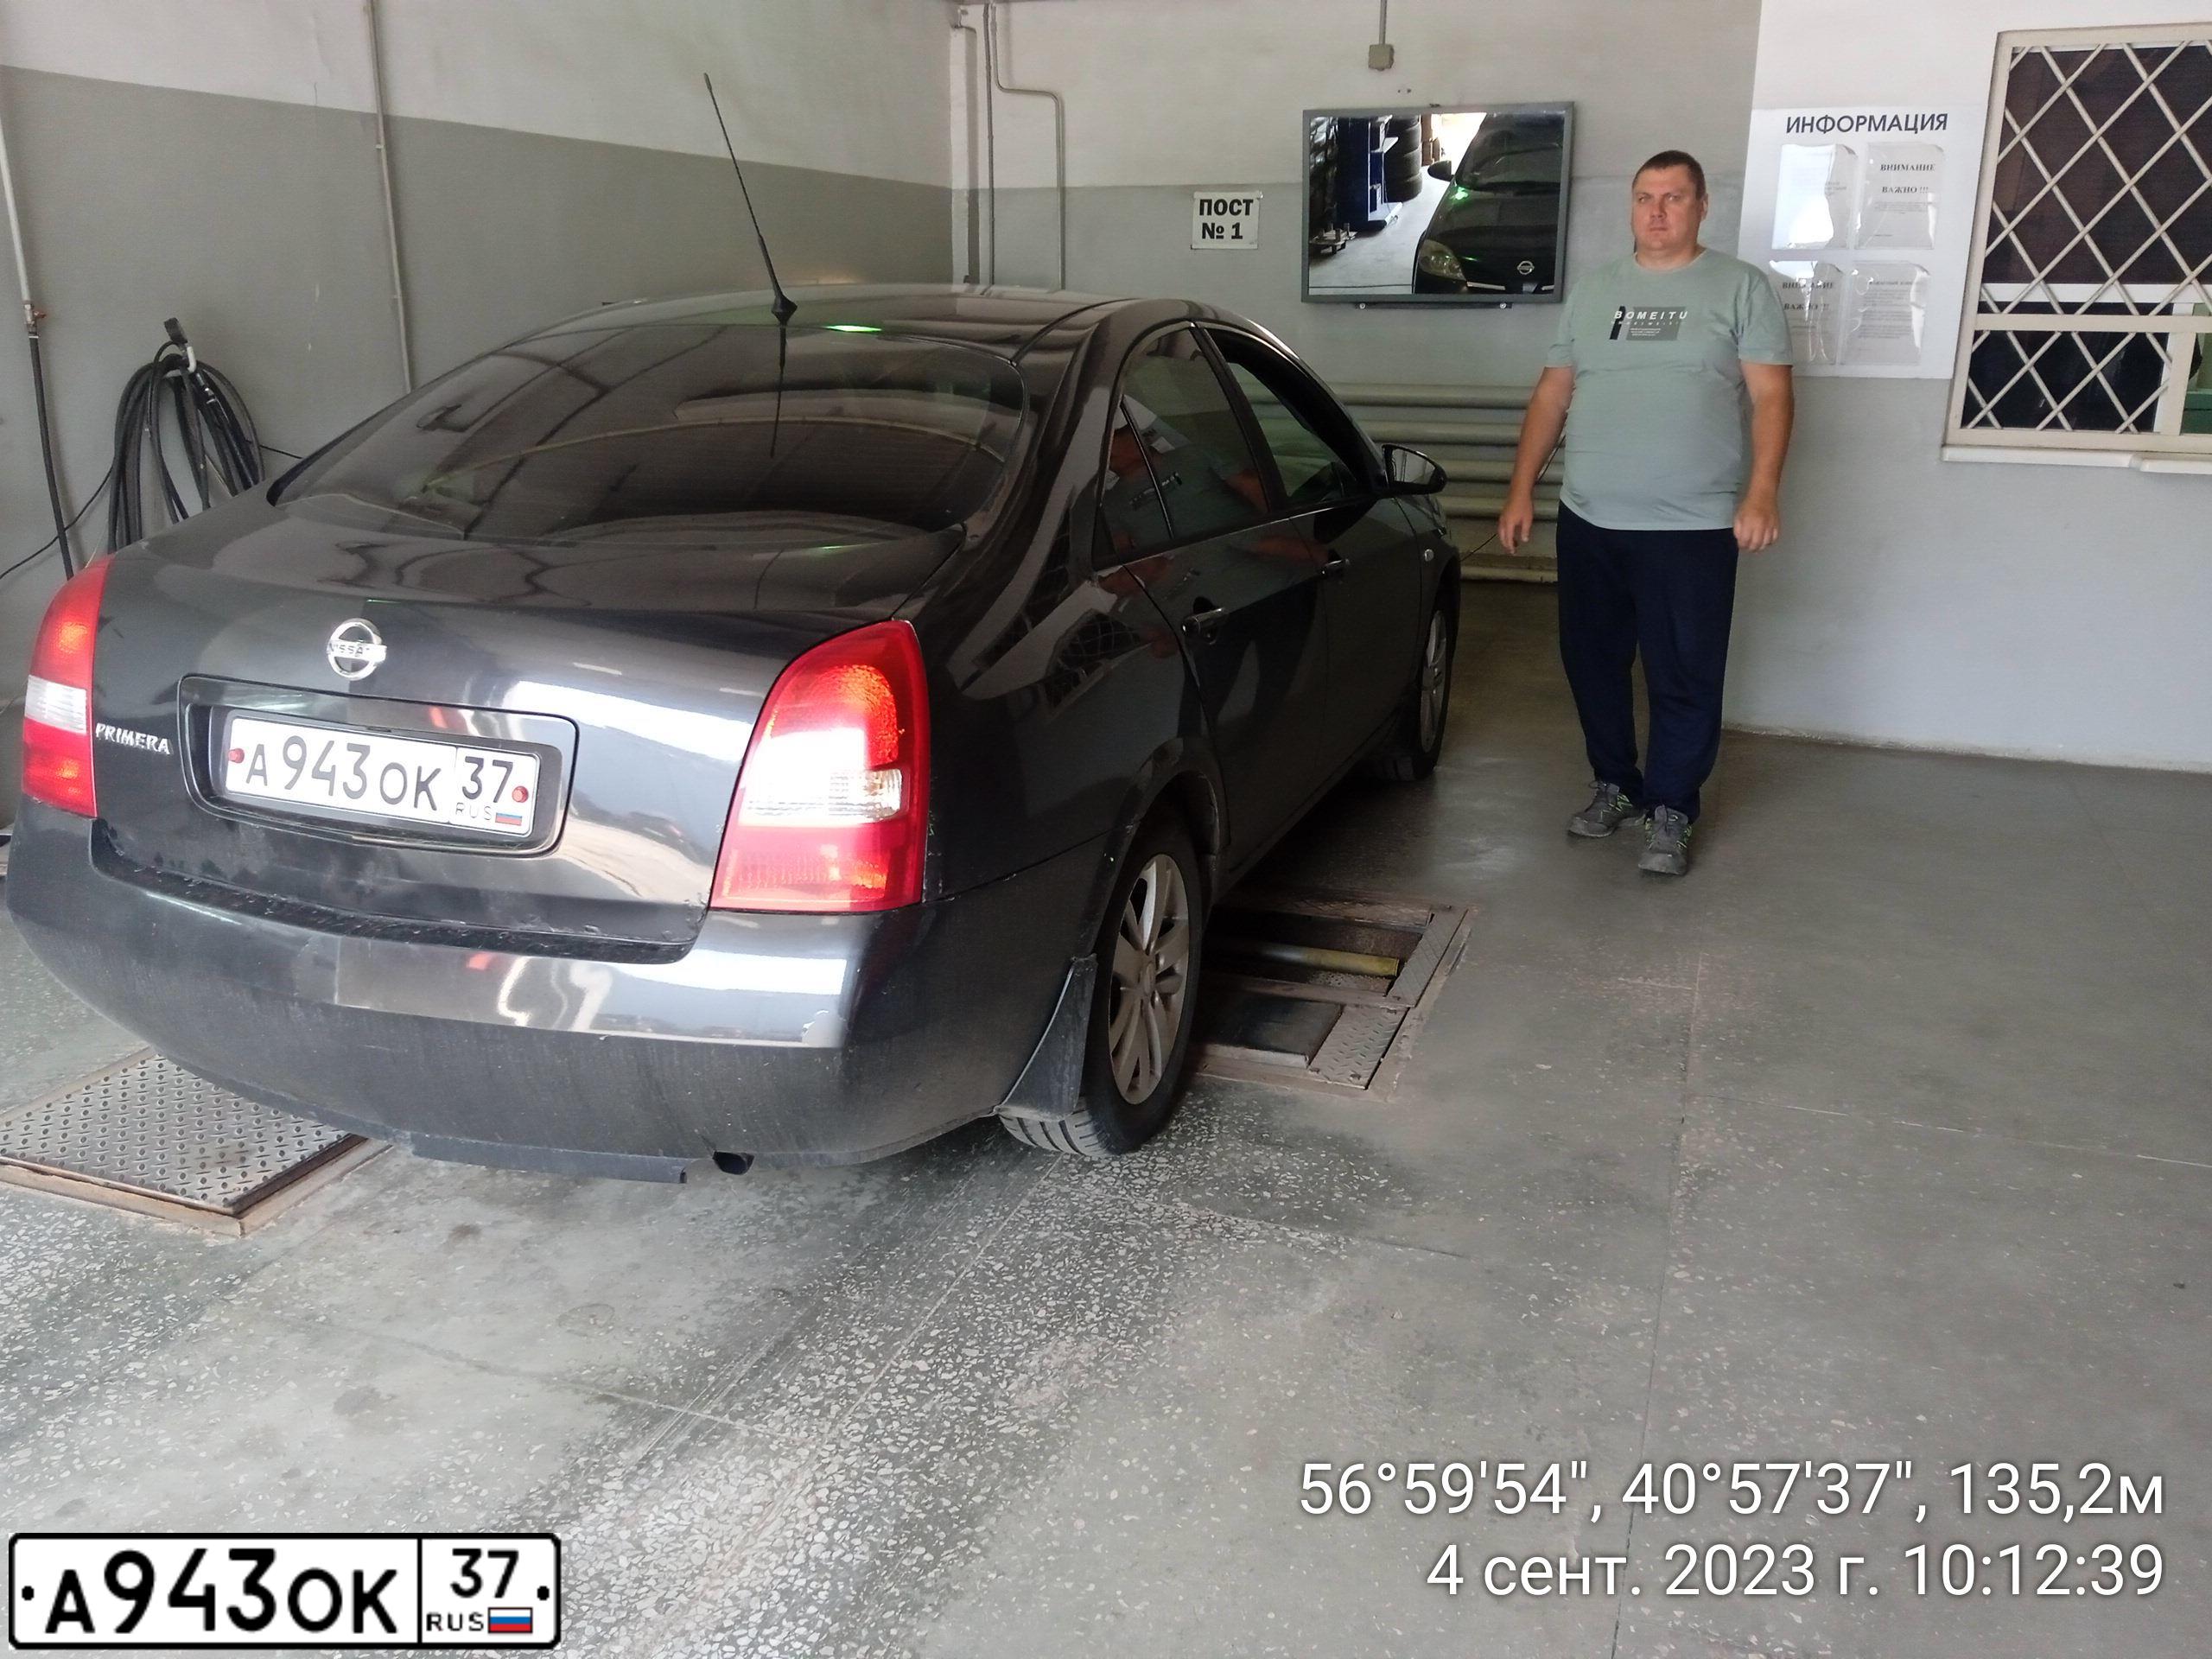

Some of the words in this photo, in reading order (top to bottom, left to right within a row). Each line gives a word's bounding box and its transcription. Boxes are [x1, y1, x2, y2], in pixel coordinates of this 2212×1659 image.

[1786, 113, 1948, 135] ИНФОРМАЦИЯ
[1198, 198, 1254, 216] ПОСТ
[1201, 222, 1225, 239] №
[1230, 222, 1243, 240] 1
[1613, 310, 1688, 320] BOMEITU
[95, 722, 172, 754] PRIMERA
[461, 755, 514, 804] 37
[455, 802, 493, 822] RUS
